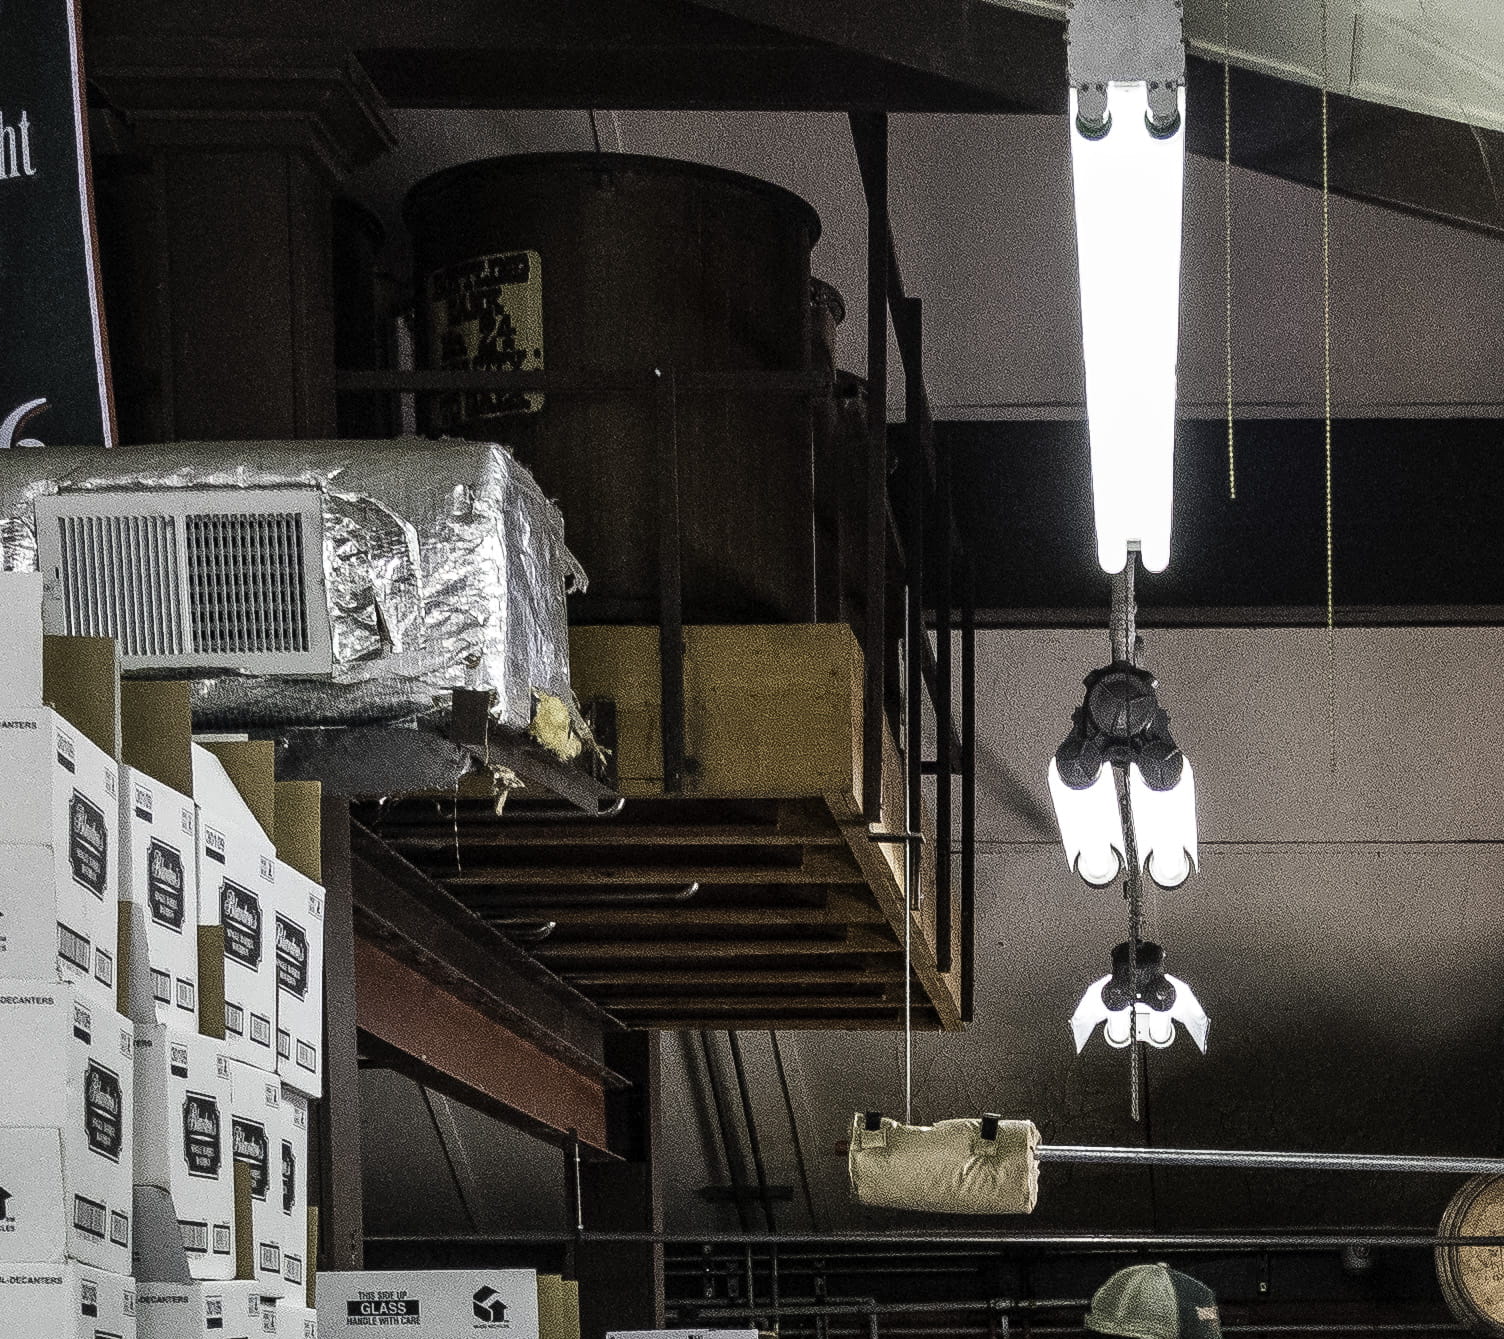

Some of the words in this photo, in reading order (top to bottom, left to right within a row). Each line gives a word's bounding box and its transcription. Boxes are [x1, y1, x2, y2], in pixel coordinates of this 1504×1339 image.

[396, 1291, 407, 1299] UP
[361, 1302, 406, 1315] GLASS
[347, 1316, 376, 1325] HANDLE
[379, 1316, 399, 1325] WITH
[401, 1316, 421, 1325] CARE
